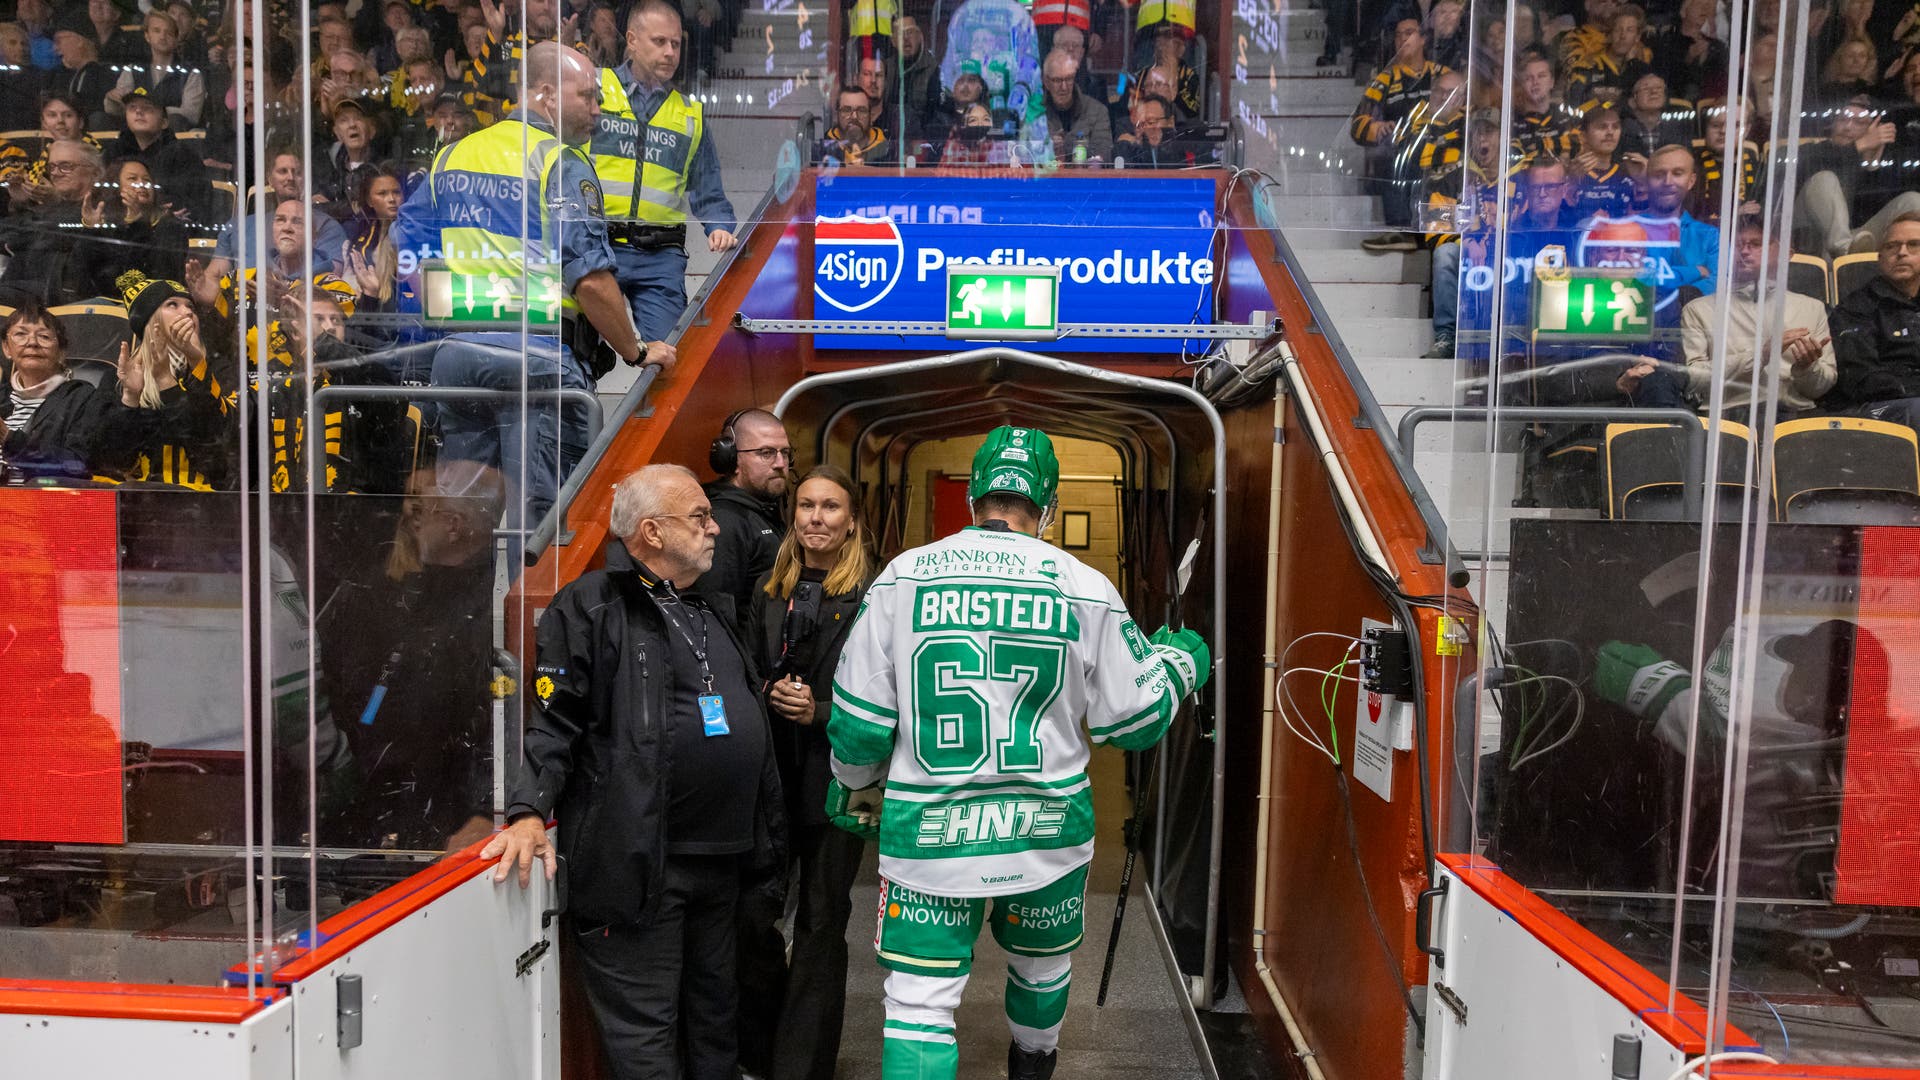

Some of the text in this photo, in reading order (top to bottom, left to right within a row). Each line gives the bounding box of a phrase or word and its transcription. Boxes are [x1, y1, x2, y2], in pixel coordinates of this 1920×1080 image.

[600, 118, 677, 148] ORDNINGS
[619, 140, 662, 162] VAKT
[437, 173, 524, 201] ORDNINGS
[818, 247, 1214, 288] 4Sign Produkte
[1012, 429, 1028, 437] 67
[913, 563, 1025, 576] FASTIGHETER
[915, 549, 1026, 568] BRÄNNBORN
[920, 590, 1069, 632] BRISTEDT
[911, 635, 1067, 777] 67
[1368, 692, 1383, 708] STOP
[989, 874, 1024, 884] BAUER
[902, 906, 970, 927] NOVUM
[1008, 896, 1082, 919] CERNITOL
[1022, 903, 1081, 930] NOVUM
